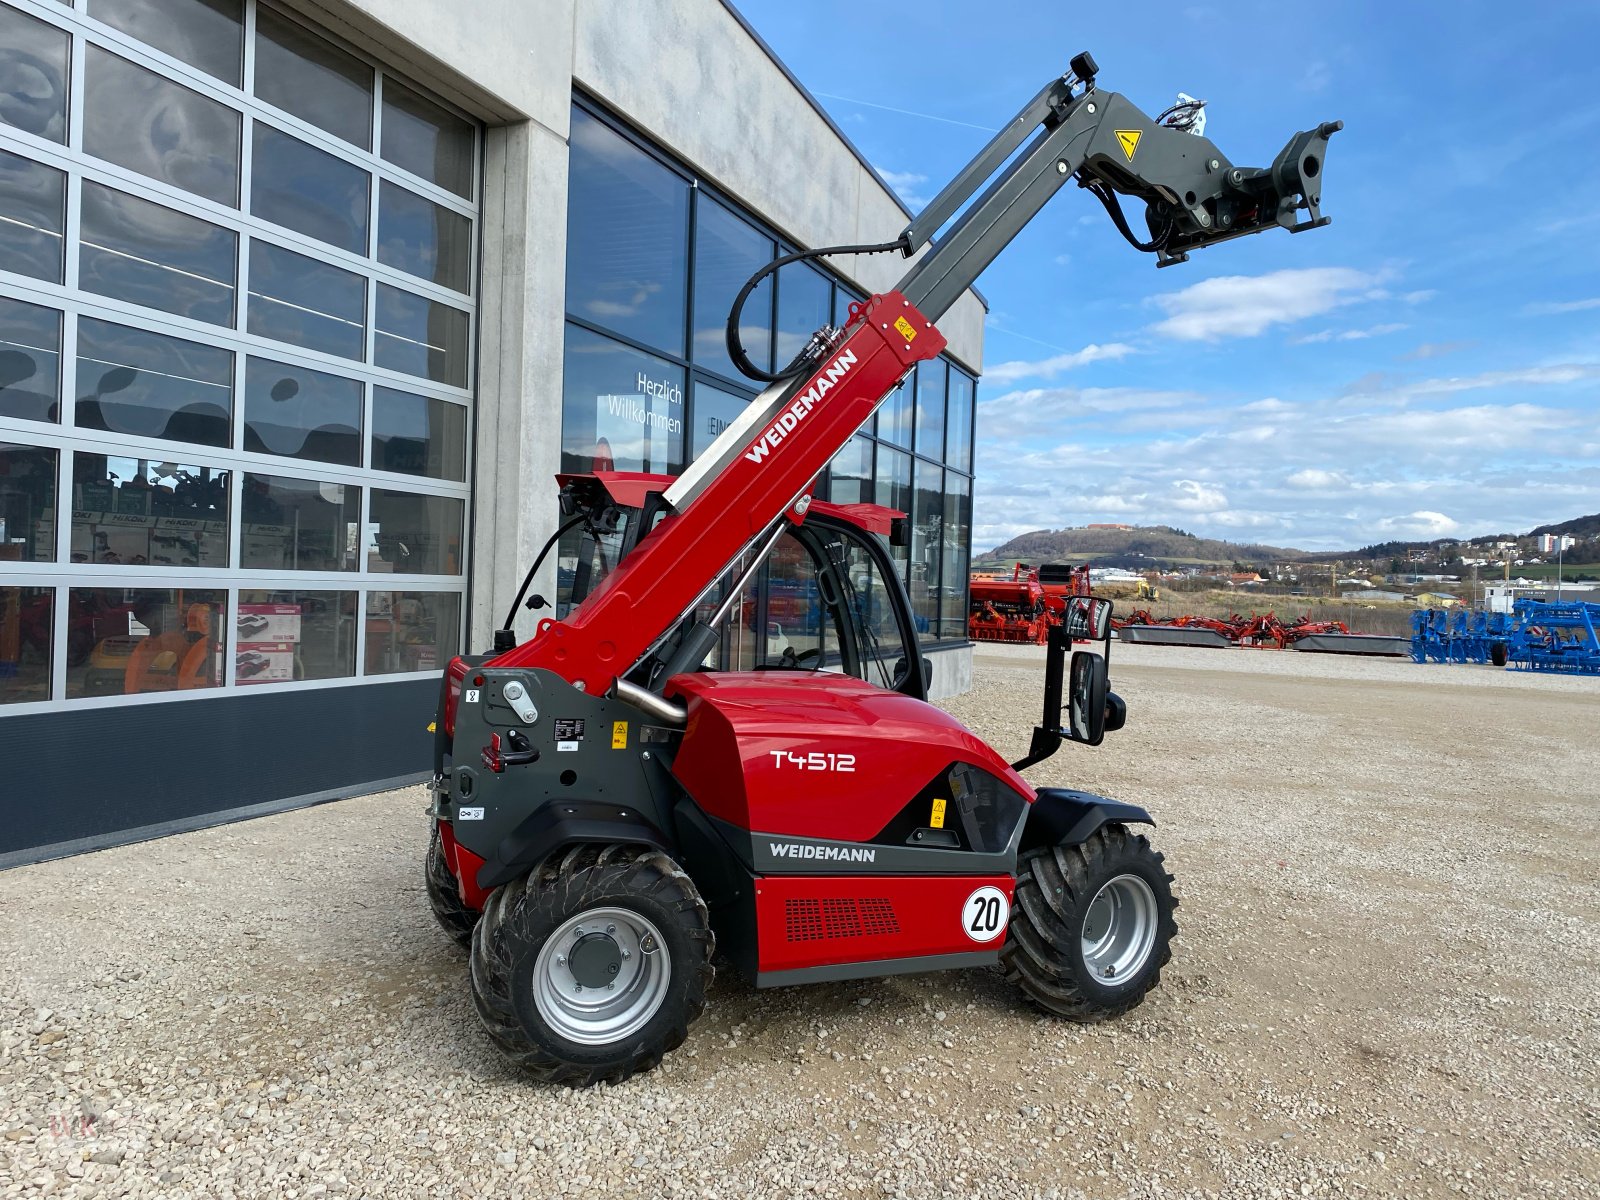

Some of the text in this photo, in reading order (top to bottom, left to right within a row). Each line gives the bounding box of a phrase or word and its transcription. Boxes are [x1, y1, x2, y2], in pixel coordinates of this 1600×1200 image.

[638, 371, 682, 405] Herzlich
[608, 393, 681, 434] Willkommen
[745, 348, 858, 464] WEIDEMANN
[710, 417, 732, 436] EIN
[769, 750, 856, 772] T4512
[769, 842, 876, 863] WEIDEMANN
[971, 896, 1001, 932] 20
